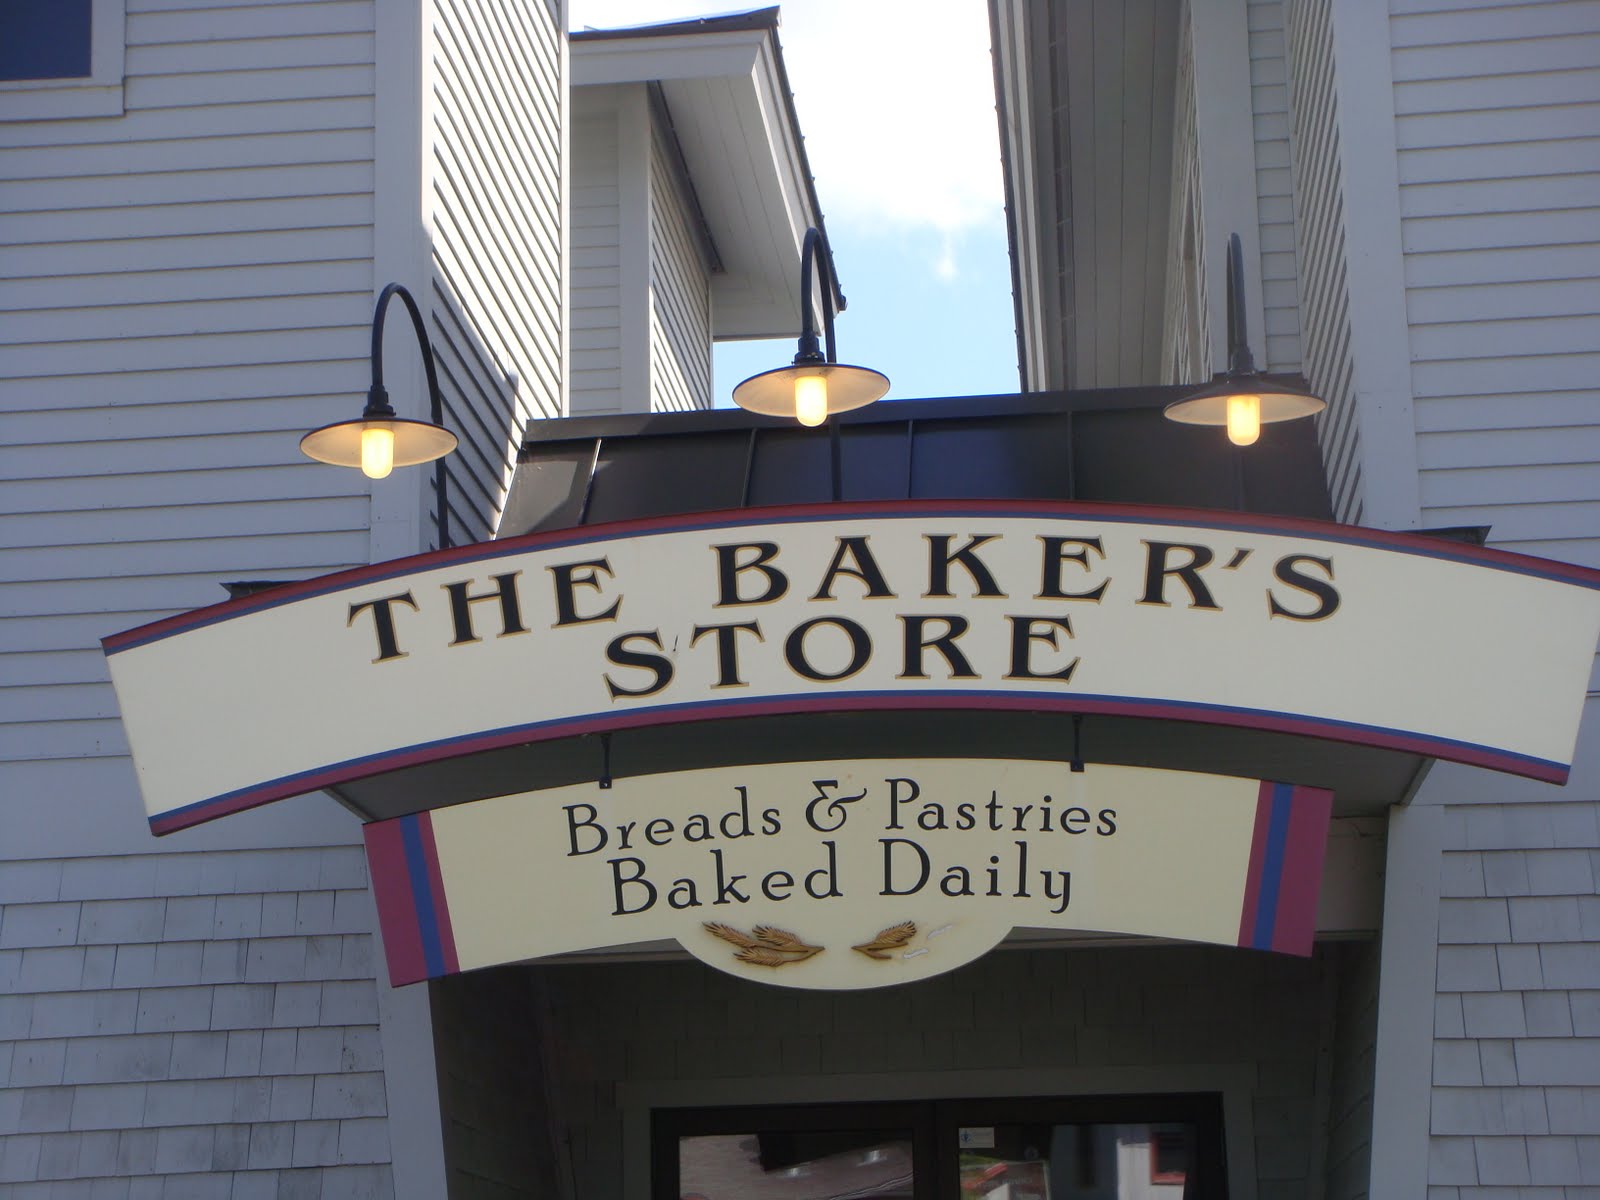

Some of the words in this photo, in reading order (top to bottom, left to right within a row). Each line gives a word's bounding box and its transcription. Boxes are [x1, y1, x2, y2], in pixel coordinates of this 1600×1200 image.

[346, 555, 624, 664] THE
[709, 533, 1342, 622] BAKER'S
[603, 613, 1081, 703] STORE
[562, 786, 782, 857] Breads
[805, 780, 867, 832] &
[884, 778, 1118, 836] Pastries
[607, 841, 843, 916] Baked
[878, 838, 1072, 914] Daily
